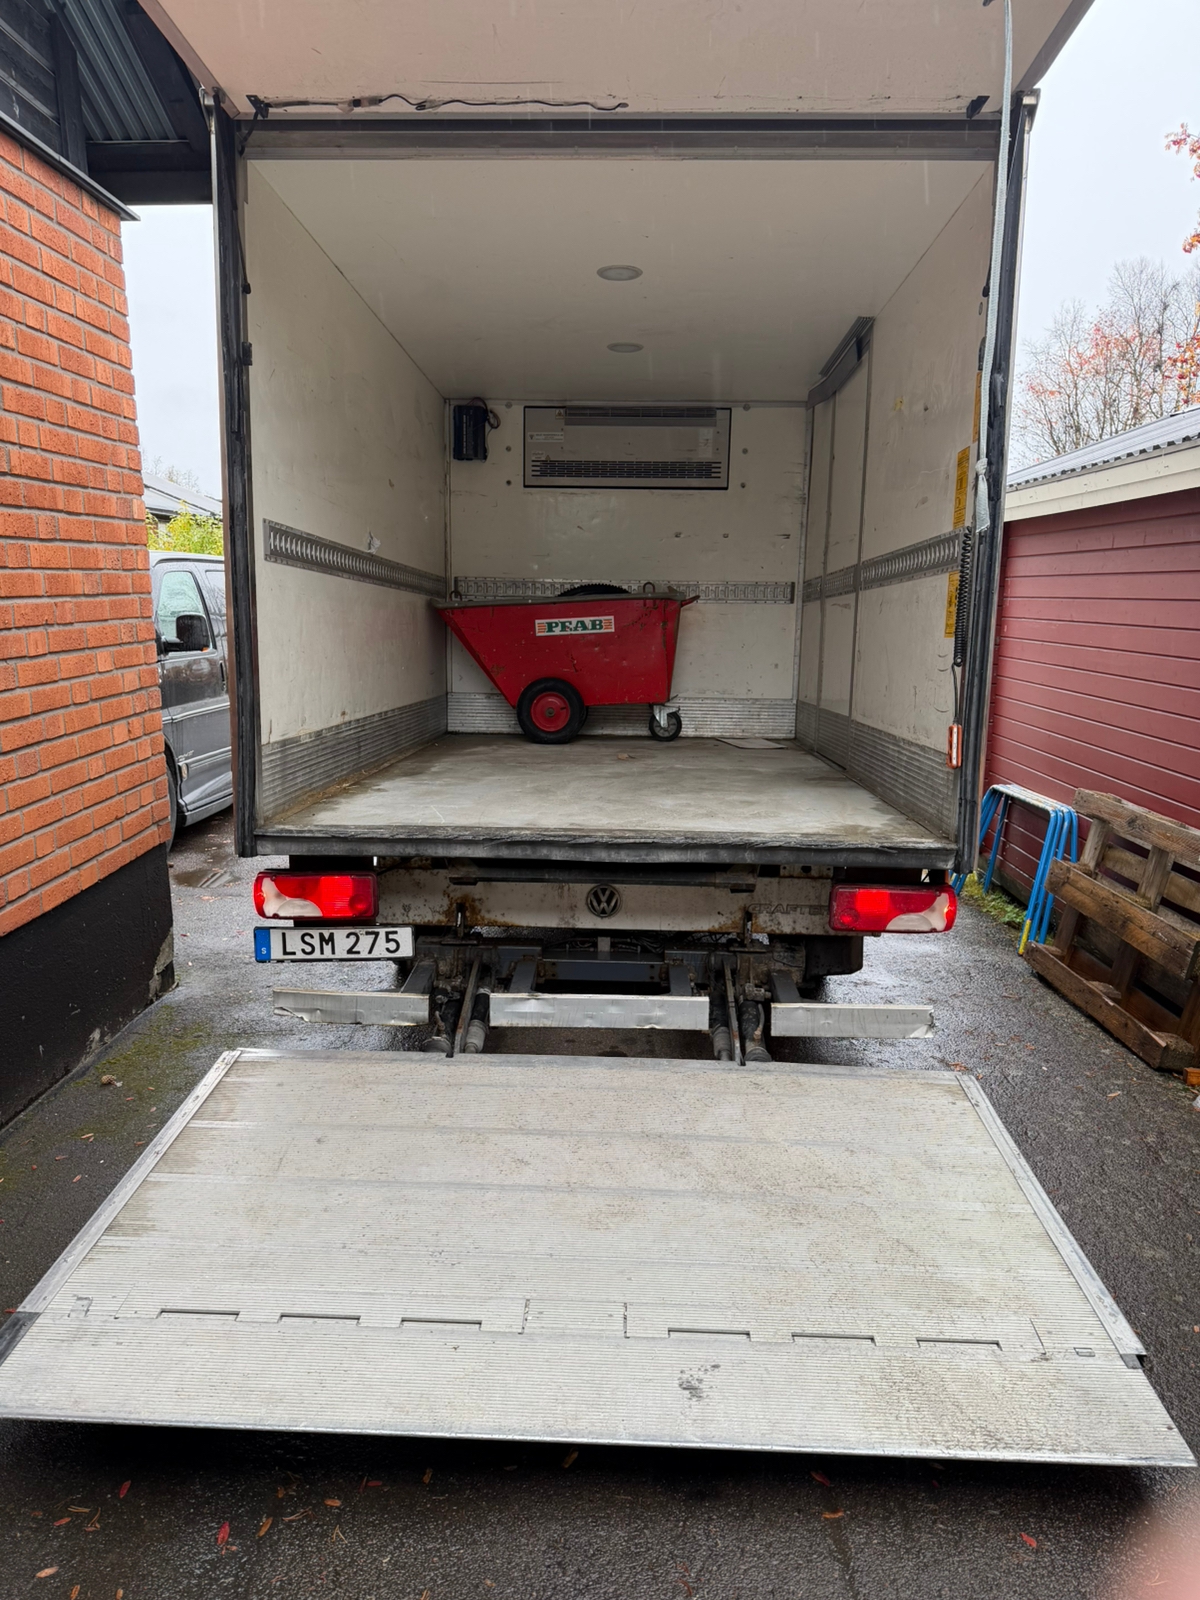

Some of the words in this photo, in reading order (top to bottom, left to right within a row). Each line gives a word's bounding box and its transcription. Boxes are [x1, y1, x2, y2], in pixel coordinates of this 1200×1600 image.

[545, 619, 604, 634] PEAB
[281, 932, 336, 956] LSM
[345, 930, 401, 955] 275
[261, 947, 267, 955] S
